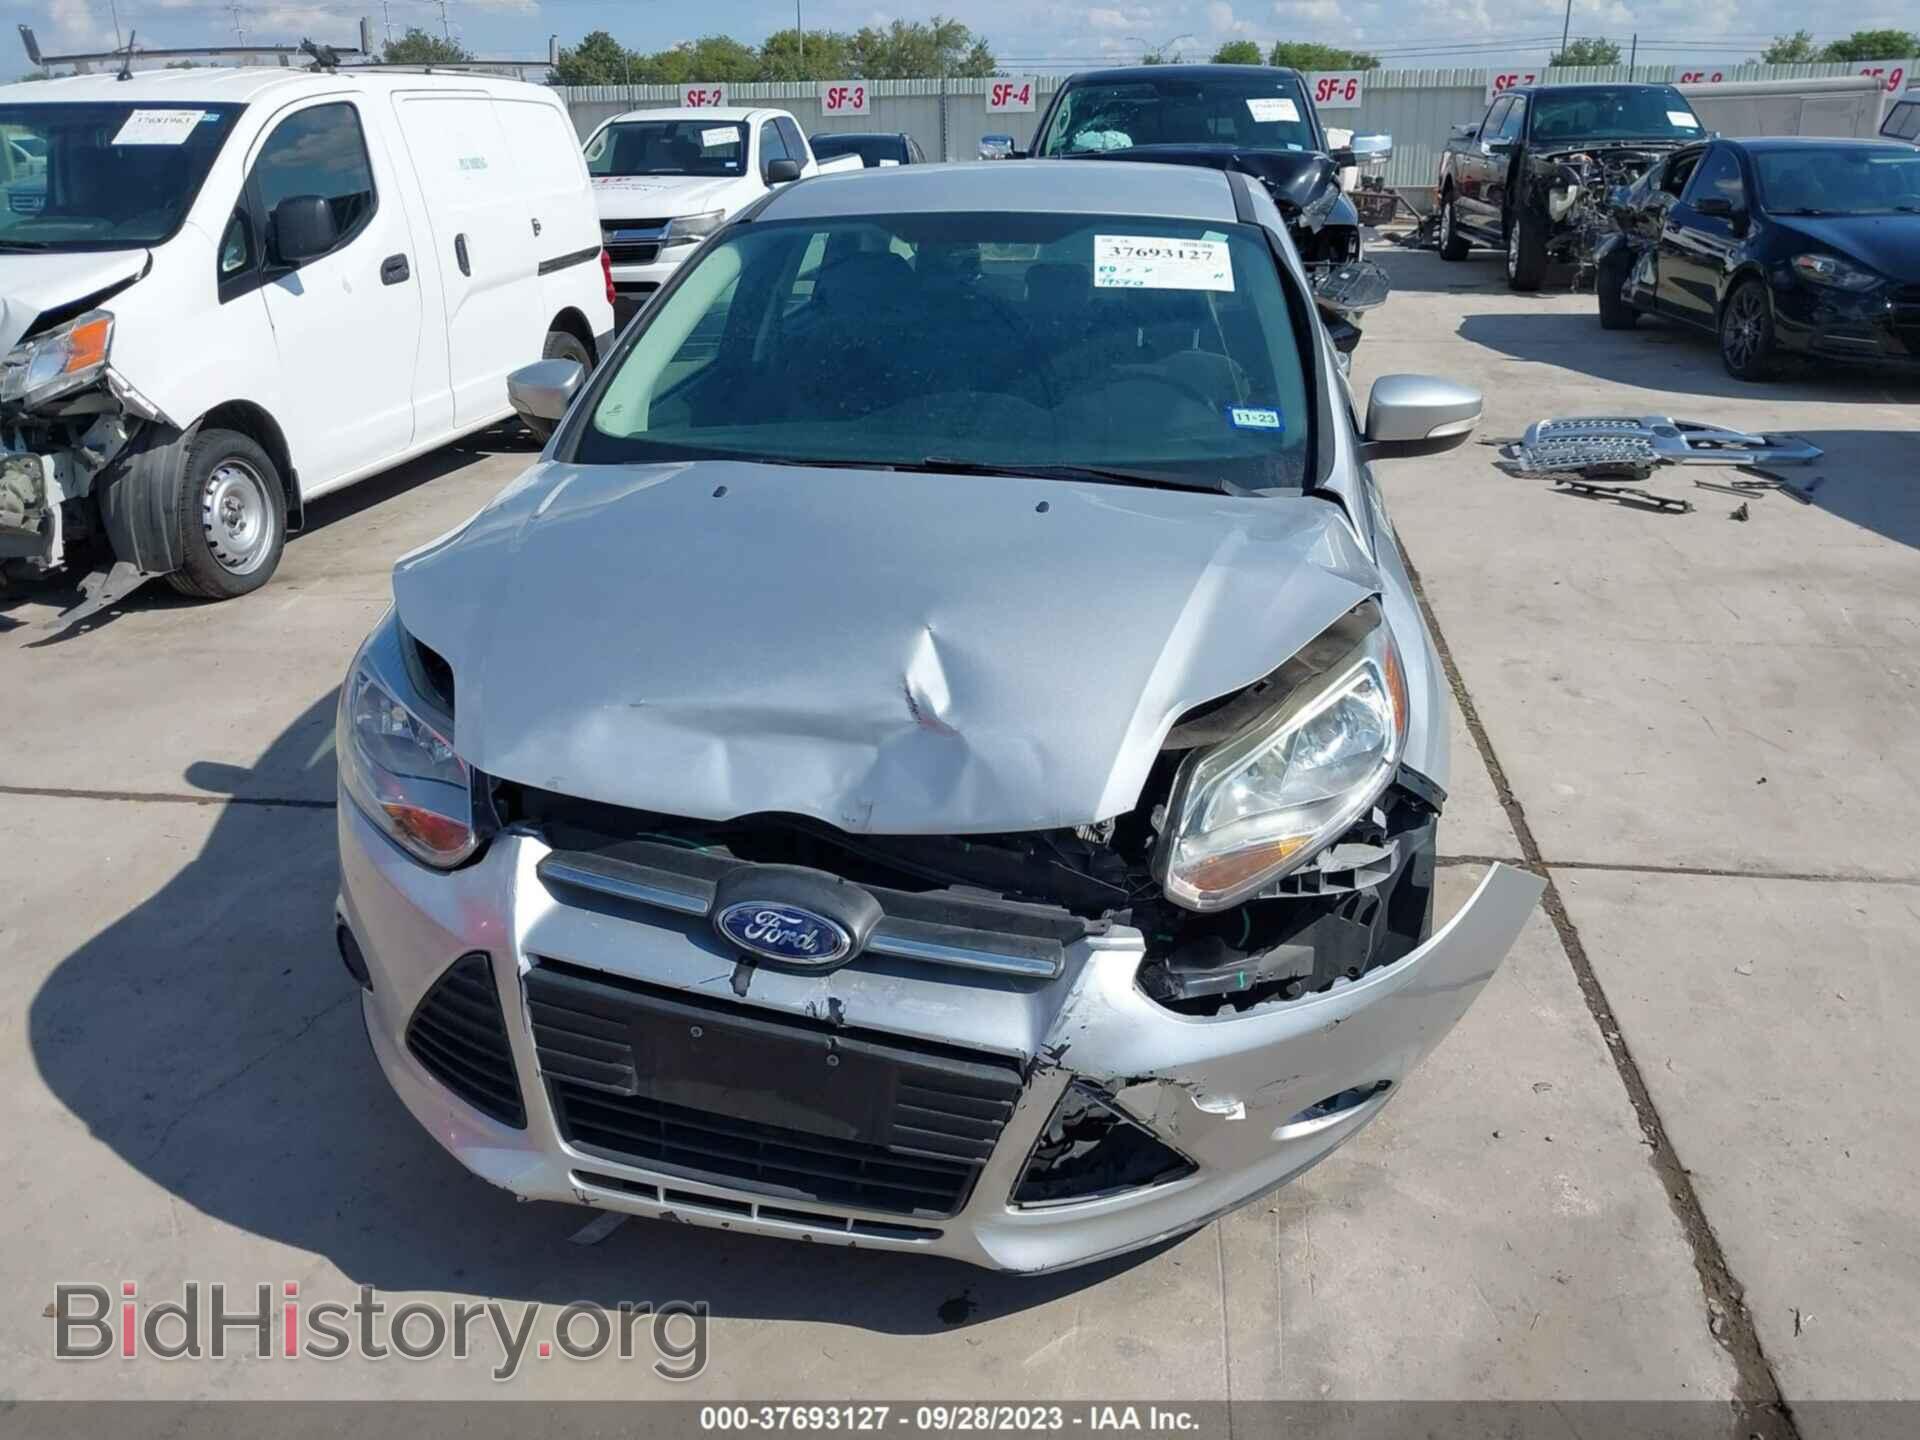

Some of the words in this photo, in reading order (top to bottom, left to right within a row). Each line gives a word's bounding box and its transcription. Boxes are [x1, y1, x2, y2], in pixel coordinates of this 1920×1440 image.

[687, 89, 722, 107] SF-2
[826, 86, 865, 110] SF-3
[991, 83, 1031, 107] SF-4
[1315, 78, 1358, 102] SF-6
[1492, 74, 1536, 98] SF7
[1108, 245, 1213, 260] 37693127
[1236, 413, 1276, 424] 11-23
[744, 910, 821, 952] Ford
